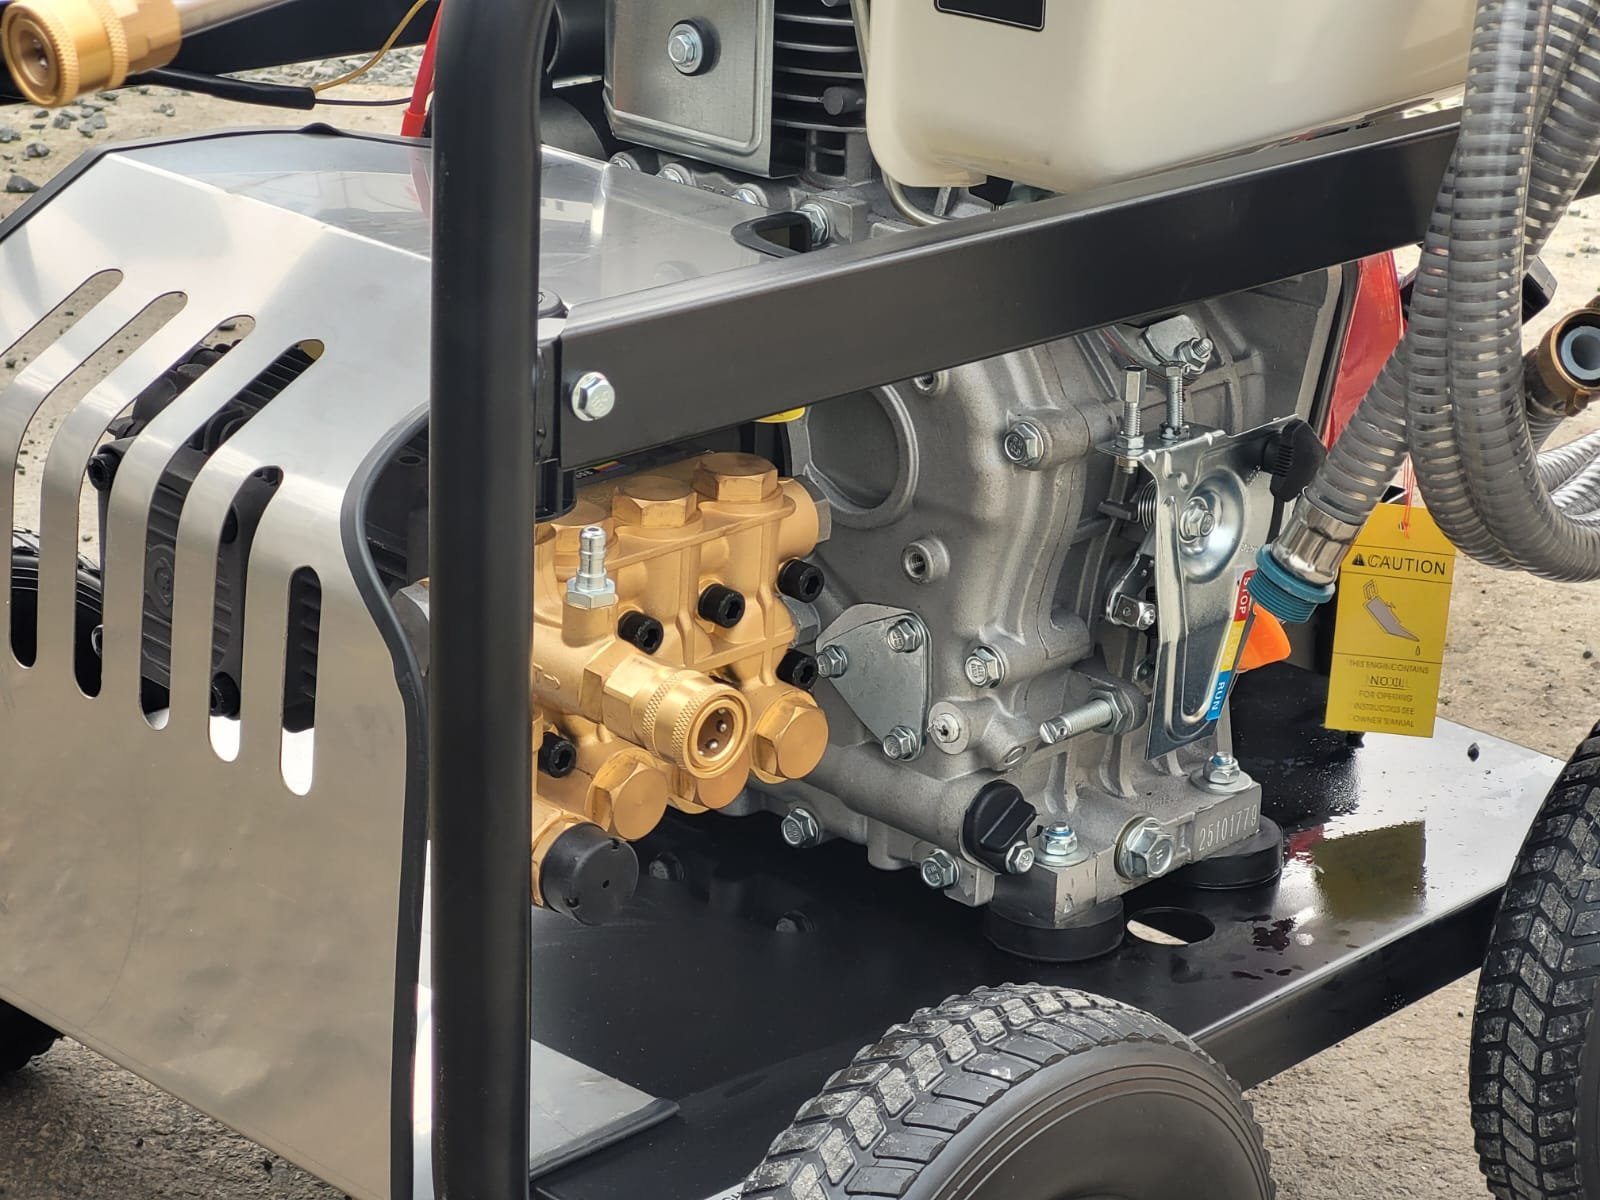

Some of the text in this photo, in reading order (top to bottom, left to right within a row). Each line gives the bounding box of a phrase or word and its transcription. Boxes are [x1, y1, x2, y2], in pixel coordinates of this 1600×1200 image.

[1368, 554, 1446, 575] CAUTION
[1240, 576, 1251, 614] STOP
[1211, 681, 1225, 711] RUN
[1198, 803, 1258, 852] 25101779
